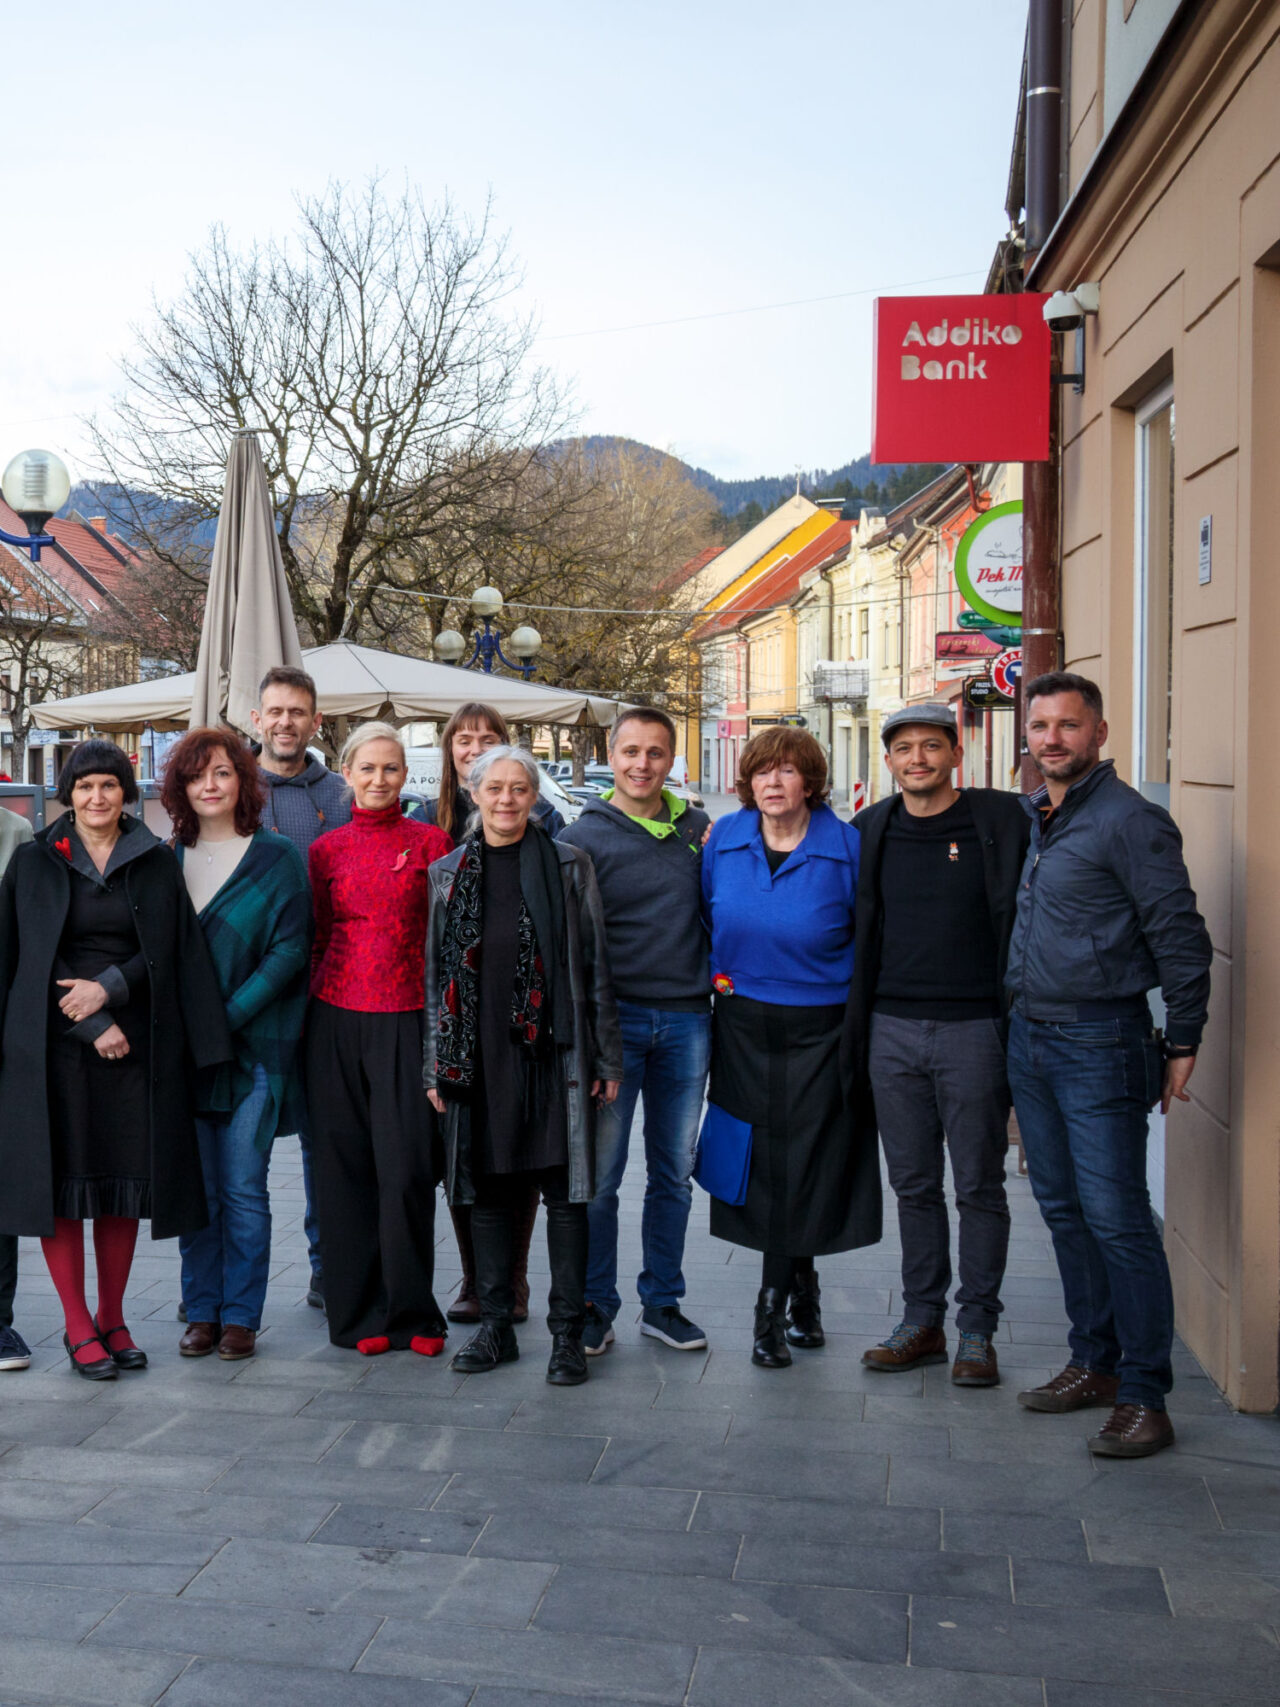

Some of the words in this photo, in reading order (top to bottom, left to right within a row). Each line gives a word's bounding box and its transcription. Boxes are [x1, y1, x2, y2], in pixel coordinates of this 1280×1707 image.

[902, 318, 1023, 347] Addiko
[901, 352, 988, 381] Bank
[976, 567, 1005, 583] Pek
